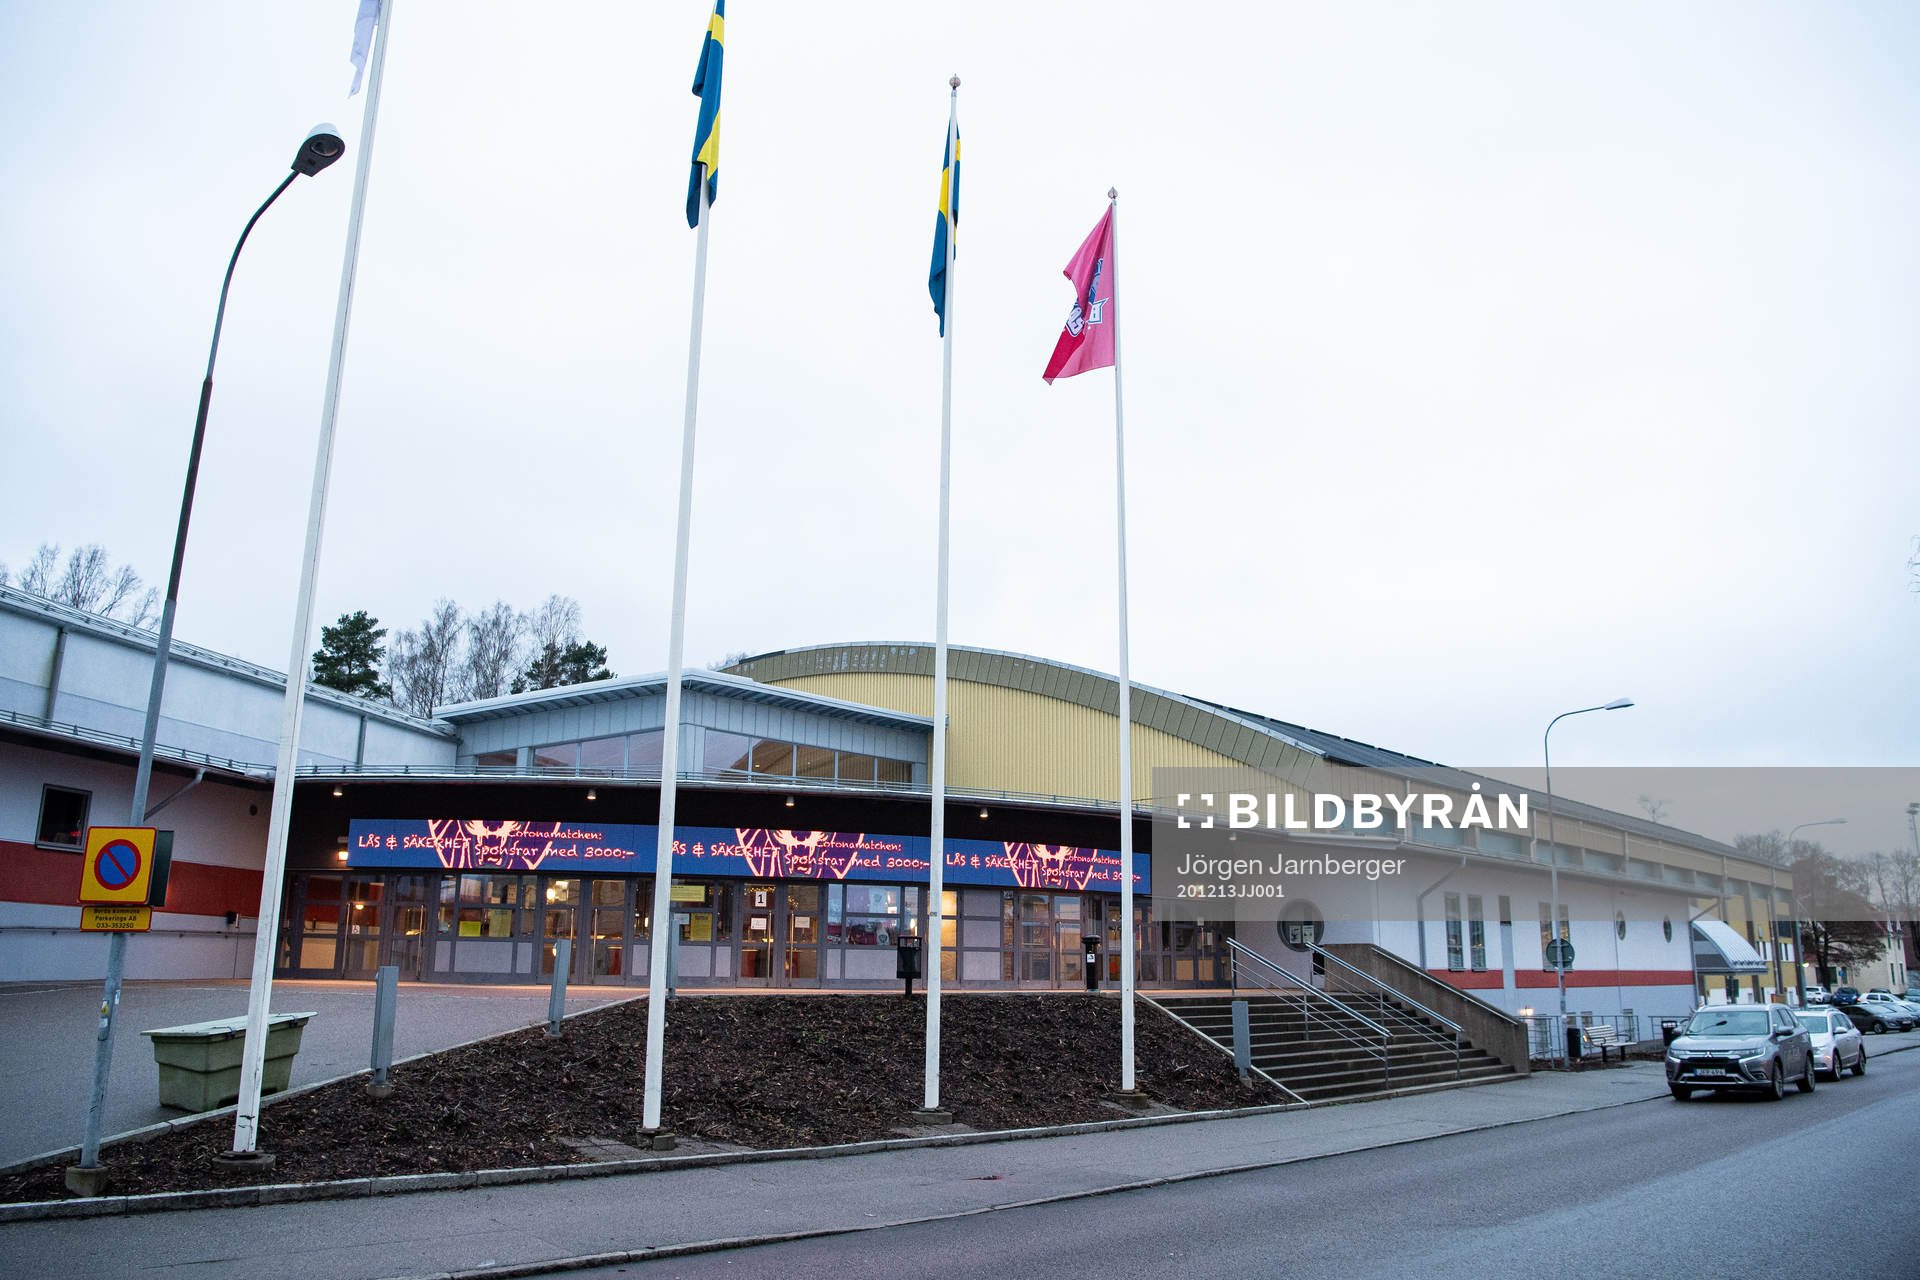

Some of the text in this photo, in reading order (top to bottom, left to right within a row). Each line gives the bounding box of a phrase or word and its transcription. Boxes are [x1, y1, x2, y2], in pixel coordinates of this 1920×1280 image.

[358, 833, 472, 850] LÅS & SÄKERHET
[545, 843, 578, 857] med
[672, 840, 781, 858] ÅS & SÄKERHET
[850, 855, 881, 868] med
[946, 852, 1040, 869] LÅS & SÄKERHET
